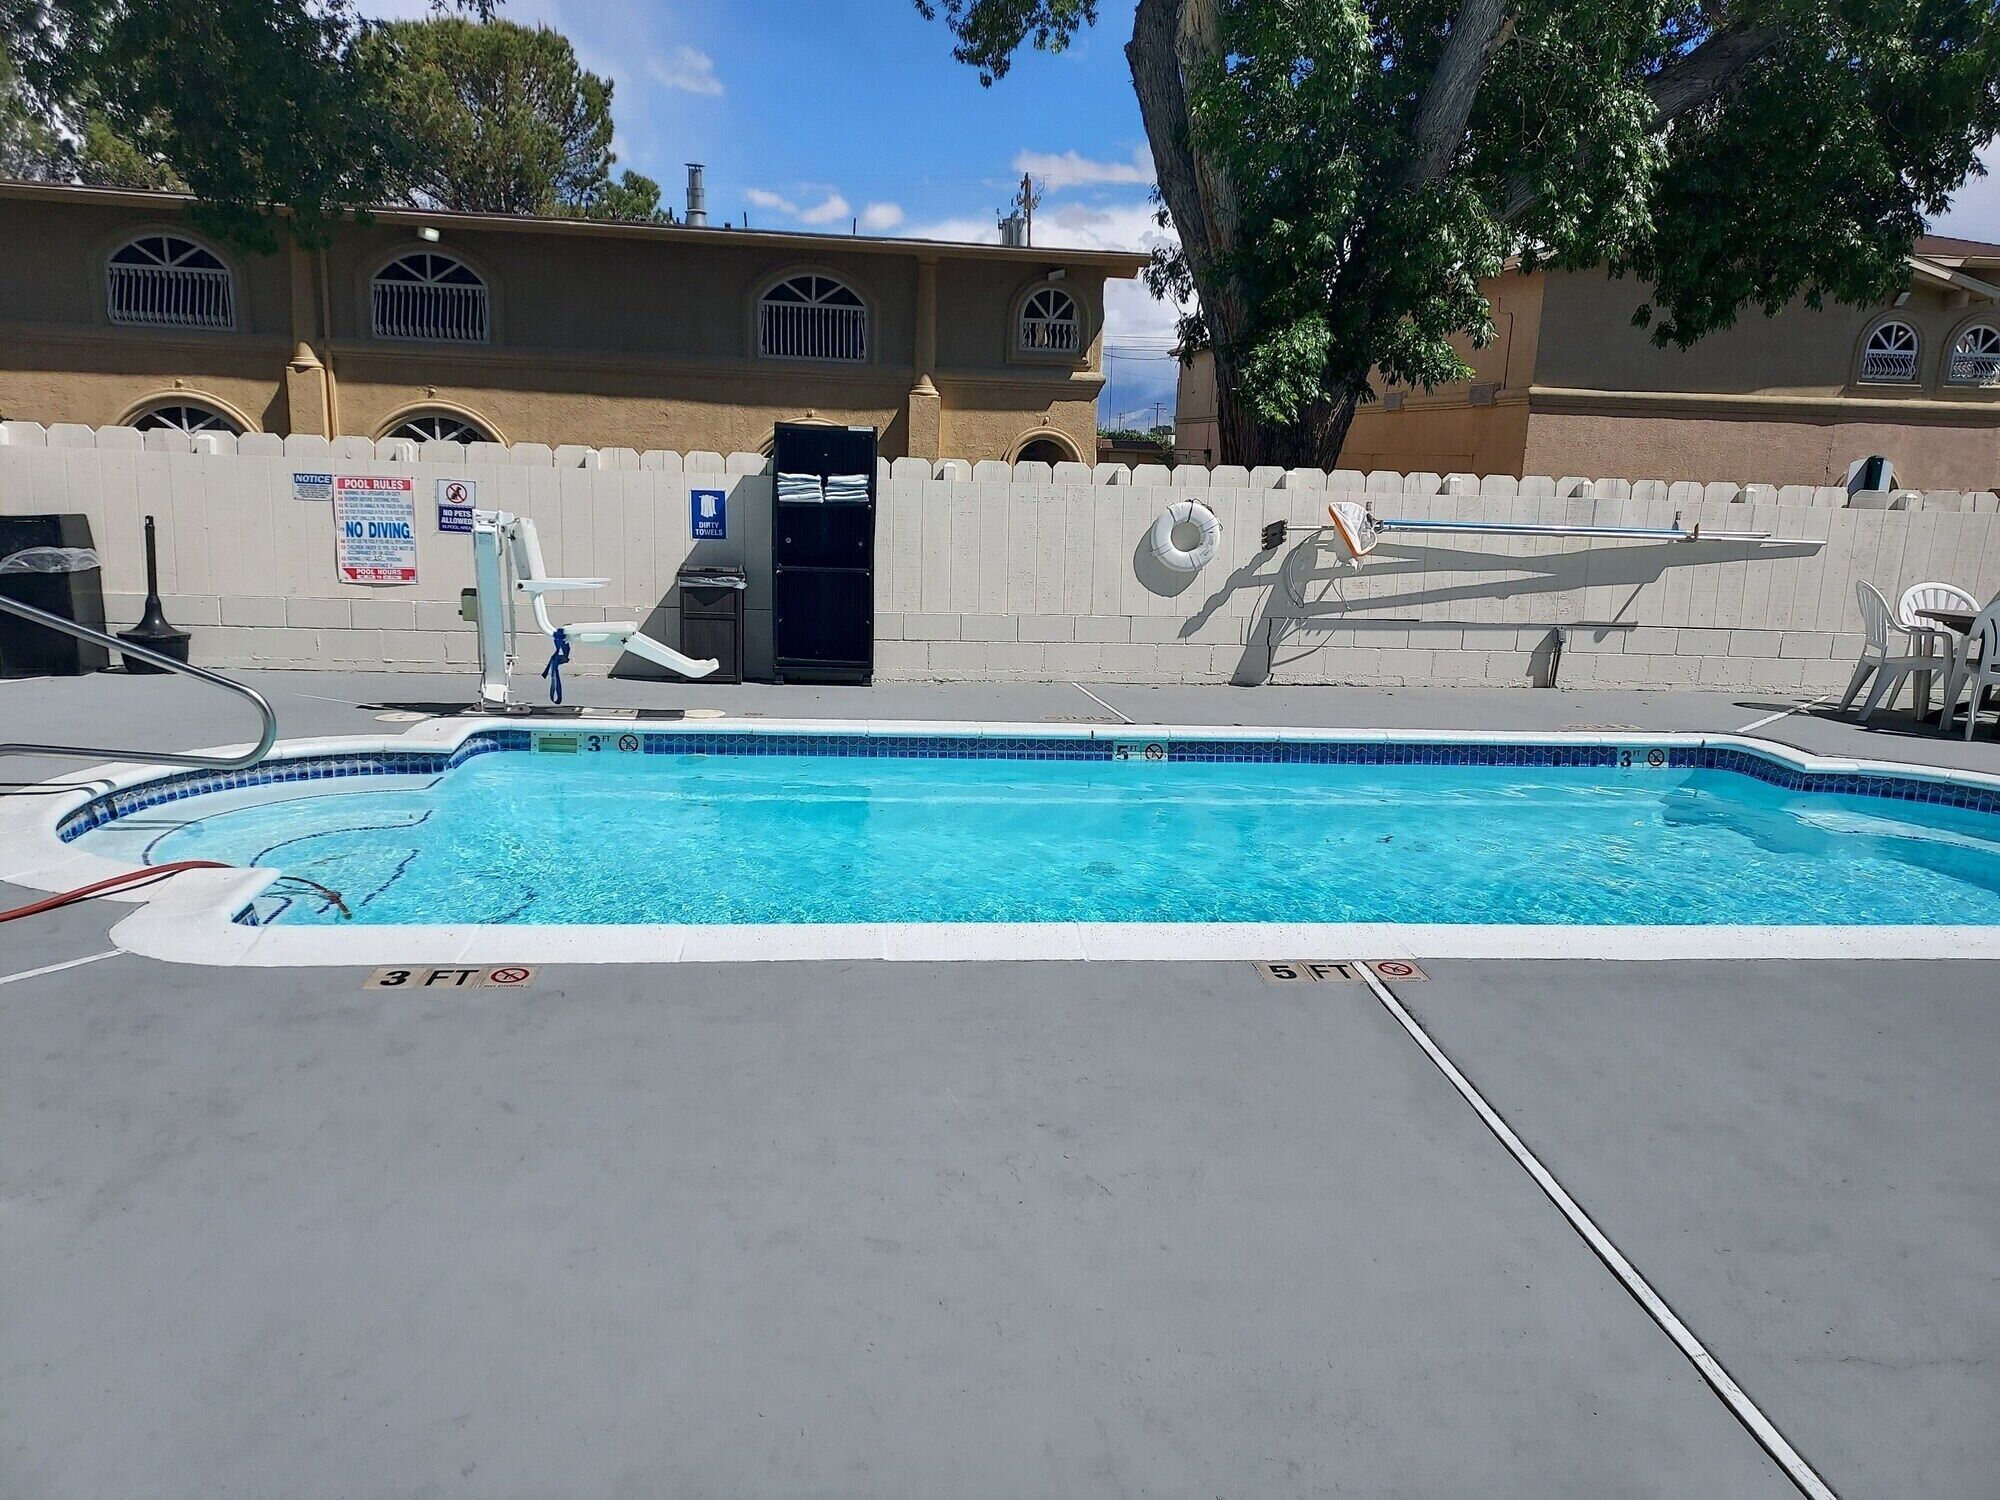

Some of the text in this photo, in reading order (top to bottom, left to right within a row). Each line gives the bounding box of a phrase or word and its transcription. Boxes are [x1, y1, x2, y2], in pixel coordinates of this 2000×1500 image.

[295, 475, 330, 484] NOTICE
[345, 479, 404, 489] POOL RULES
[346, 522, 413, 538] NO DIVING.
[588, 735, 601, 751] 3
[1116, 745, 1128, 759] 5
[1621, 750, 1632, 767] 3
[380, 970, 479, 986] 3 FT
[1269, 964, 1351, 979] 5 FT
